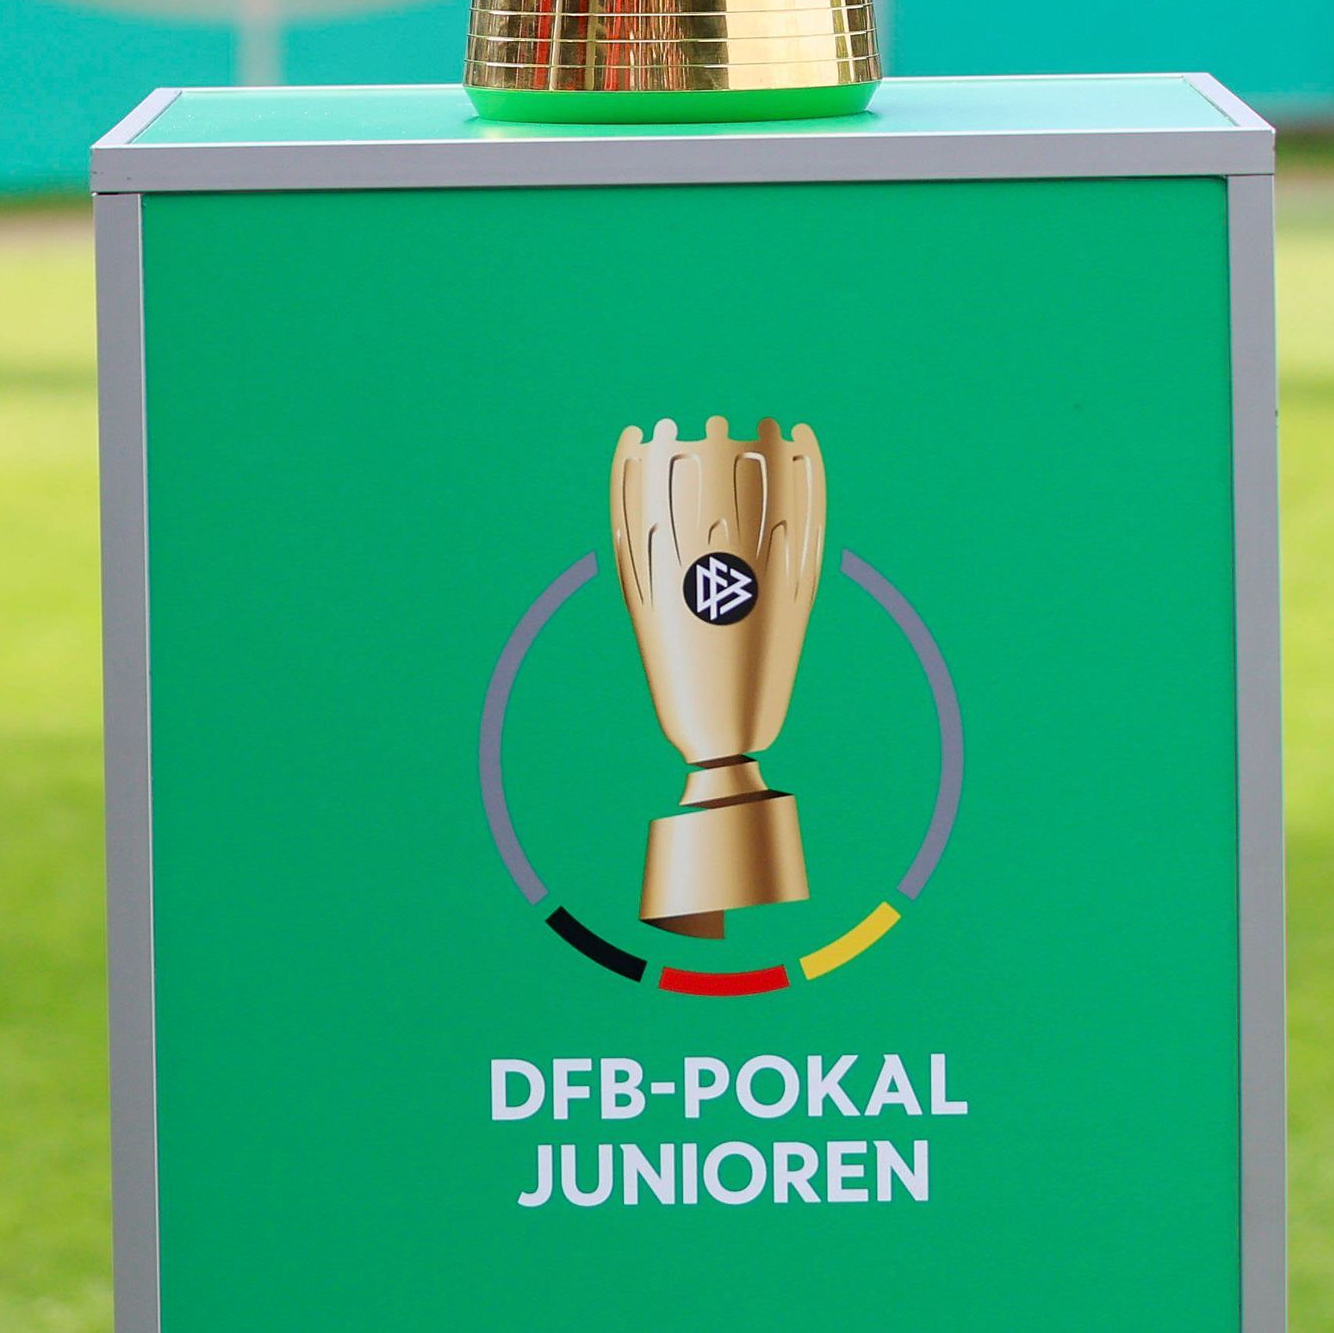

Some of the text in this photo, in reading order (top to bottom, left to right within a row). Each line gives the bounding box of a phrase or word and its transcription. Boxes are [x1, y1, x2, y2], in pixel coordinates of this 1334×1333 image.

[695, 556, 754, 621] DFB
[490, 1052, 969, 1121] DFB-POKAL
[517, 1139, 930, 1207] JUNIOREN
